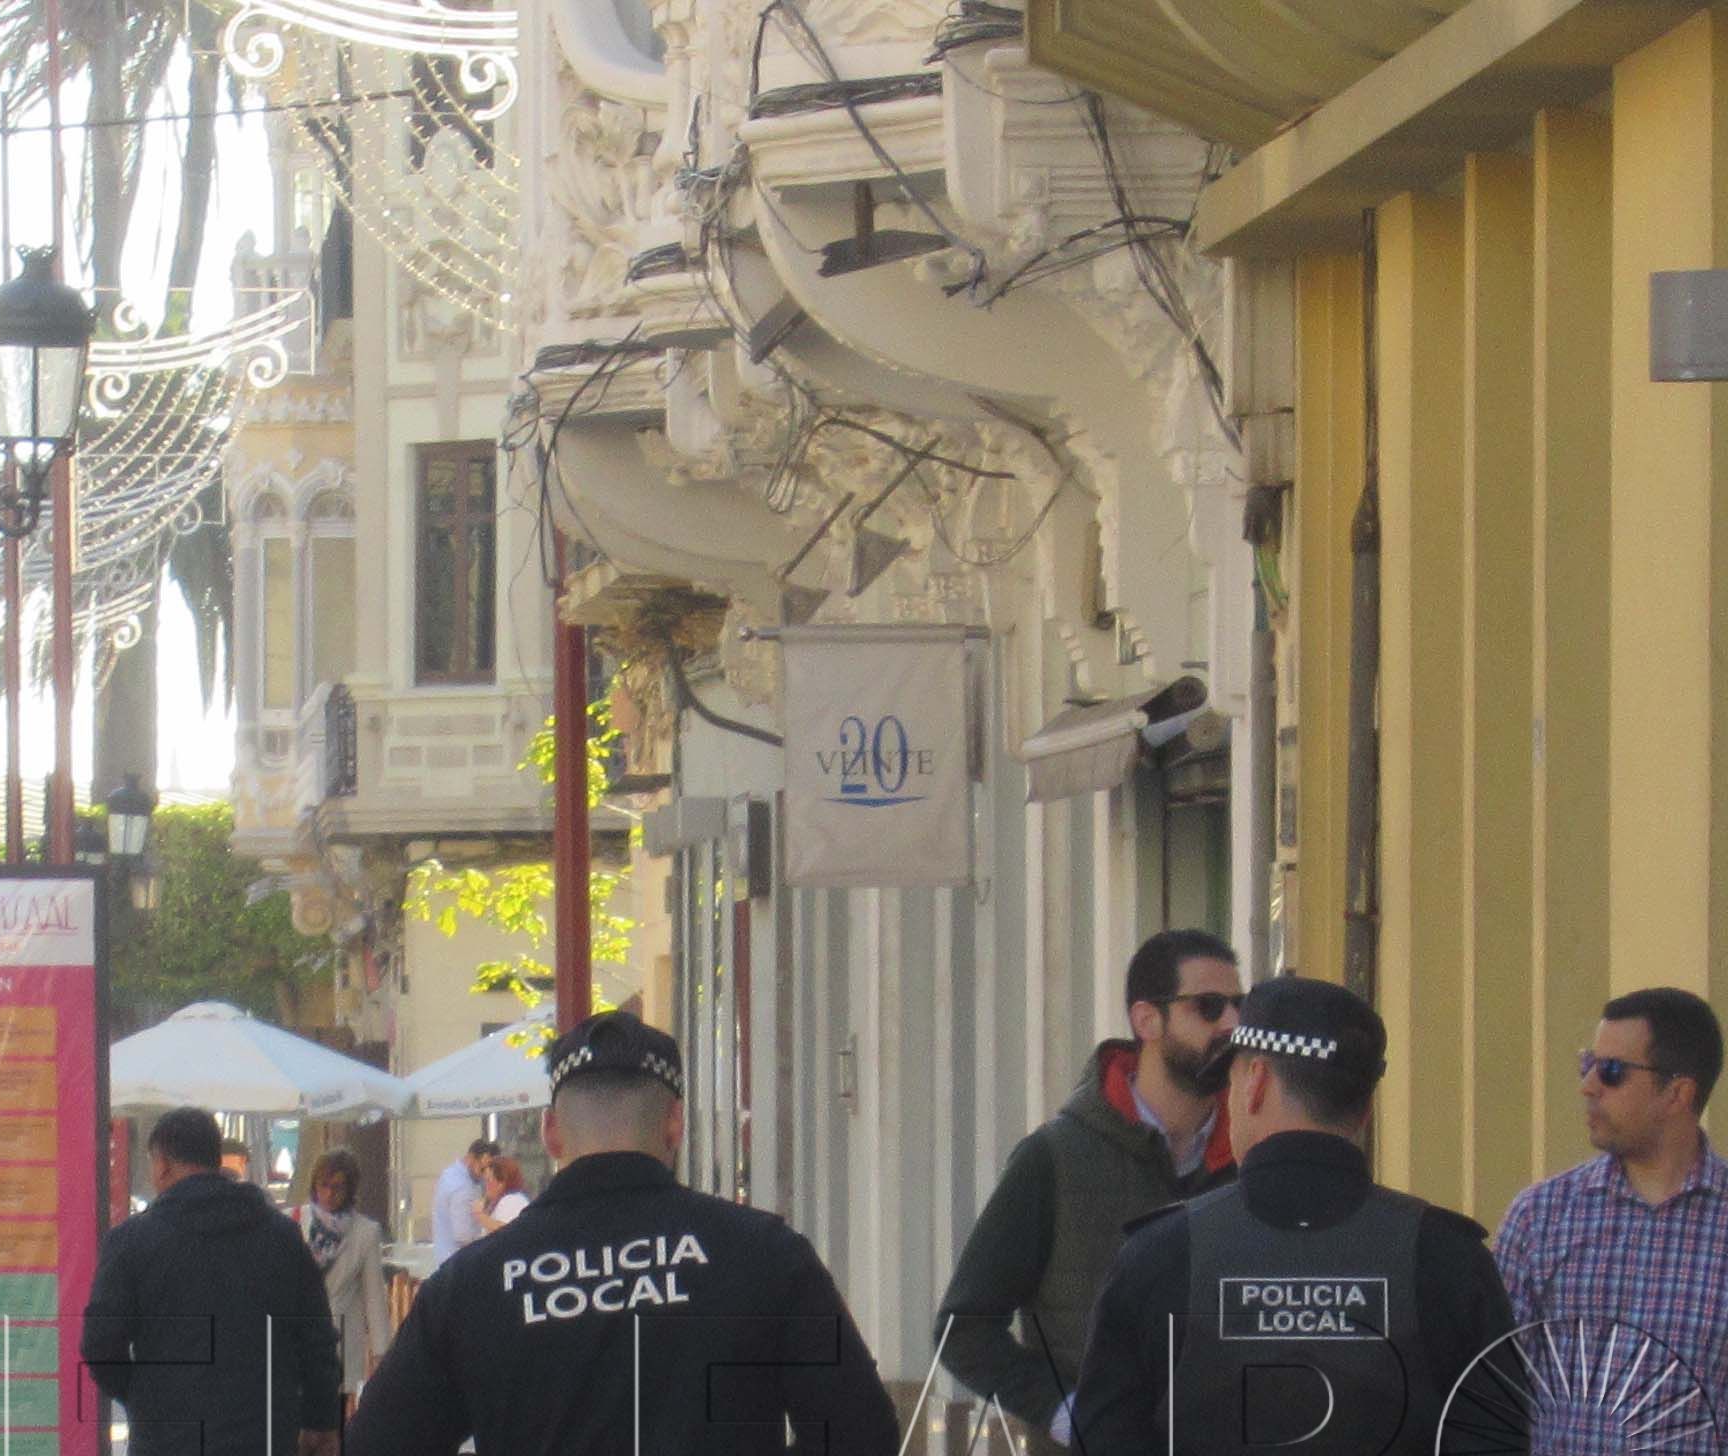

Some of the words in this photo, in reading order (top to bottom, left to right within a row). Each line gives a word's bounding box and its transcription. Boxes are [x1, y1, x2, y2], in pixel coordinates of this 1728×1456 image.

[839, 714, 909, 793] 20
[503, 1234, 710, 1292] POLICIA
[523, 1271, 690, 1325] LOCAL
[1241, 1284, 1367, 1307] POLICIA
[1258, 1310, 1355, 1333] LOCAL
